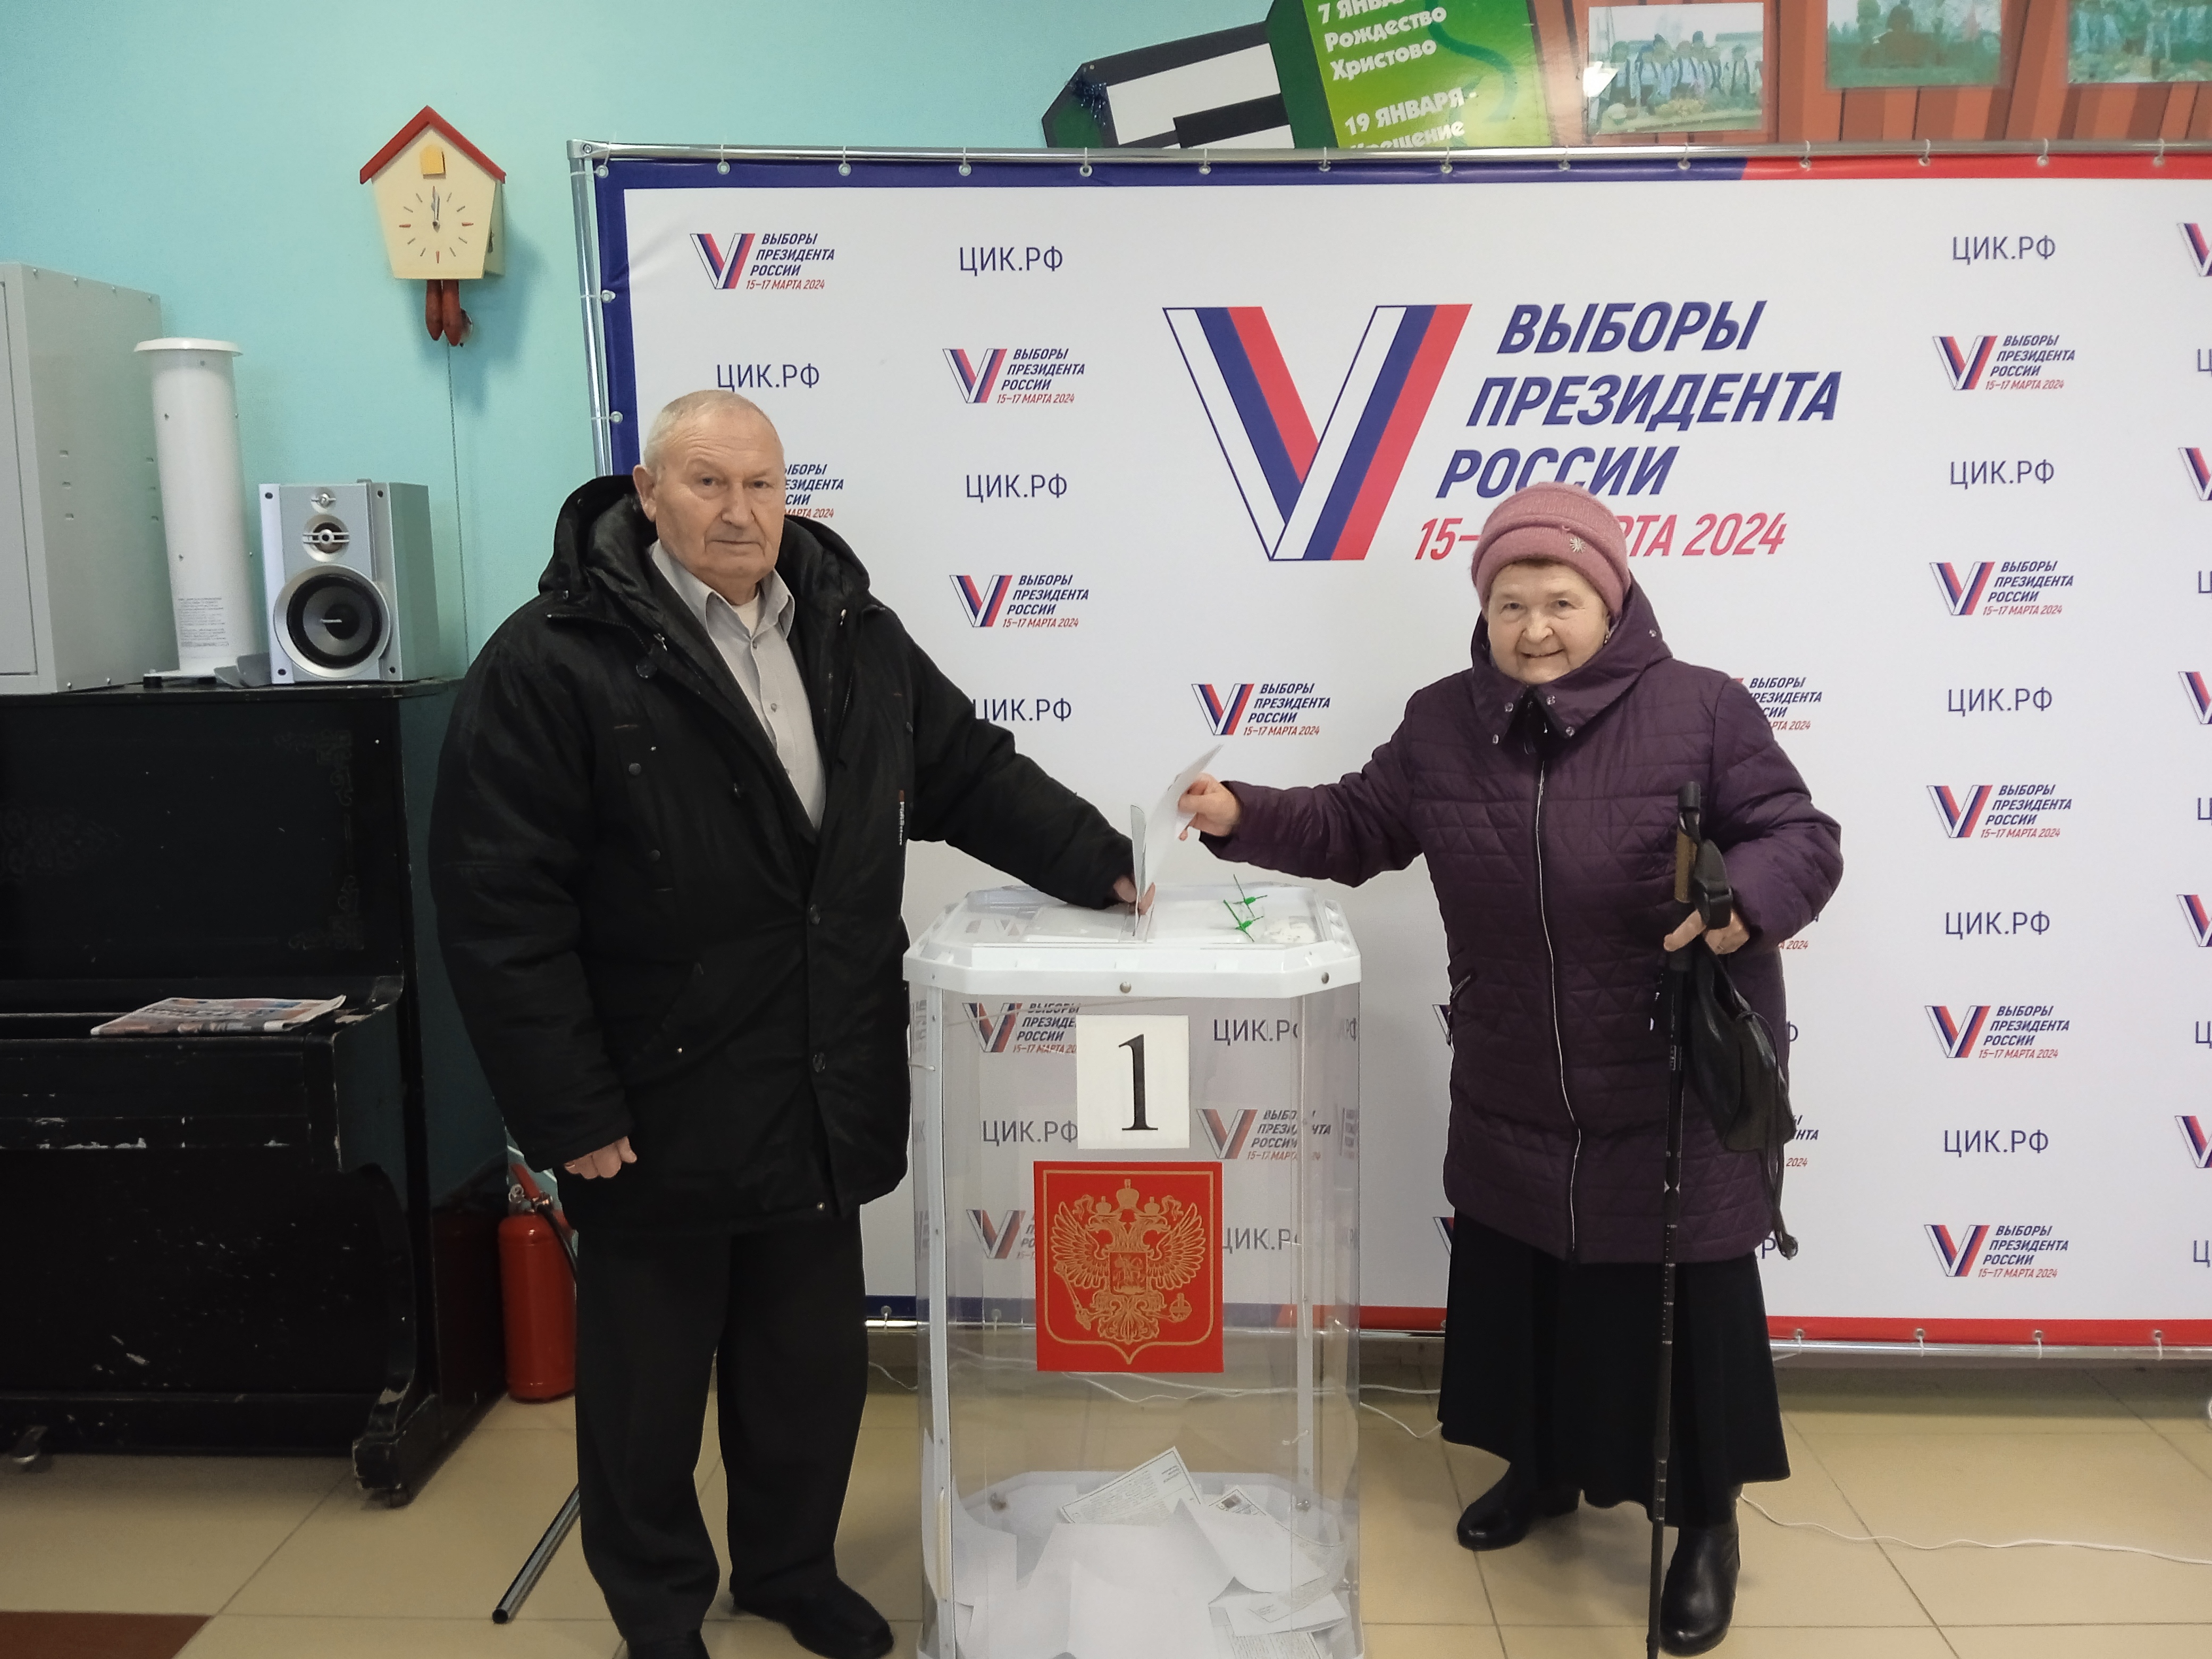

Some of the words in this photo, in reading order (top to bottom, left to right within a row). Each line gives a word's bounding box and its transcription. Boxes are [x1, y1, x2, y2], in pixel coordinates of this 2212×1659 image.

[1317, 1, 1331, 24] 7
[1324, 6, 1447, 53] Рождество
[1329, 38, 1437, 81] Христово
[1344, 112, 1371, 136] 19
[1375, 86, 1466, 129] ЯНВАРЯ
[761, 232, 817, 245] ВЫБОРЫ
[756, 248, 835, 262] ПРЕЗИДЕНТА
[1953, 236, 2055, 265] ЦИК.РФ
[960, 246, 1062, 276] ЦИК.РФ
[750, 264, 800, 276] РОССИИ
[772, 279, 801, 290] МАРТА
[803, 279, 825, 290] 2024
[1497, 299, 1768, 354] ВЫБОРЫ
[2002, 334, 2059, 346] ВЫБОРЫ
[1013, 348, 1068, 360] ВЫБОРЫ
[1996, 349, 2075, 362] ПРЕЗИДЕНТА
[1007, 363, 1085, 376] ПРЕЗИДЕНТА
[1990, 365, 2041, 376] РОССИИ
[717, 363, 818, 392] ЦИК.РФ
[1001, 379, 1051, 390] РОССИИ
[2010, 380, 2040, 389] МАРТА
[2042, 380, 2064, 389] 2024
[1023, 393, 1052, 403] МАРТА
[1054, 393, 1074, 403] 2024
[1466, 370, 1842, 432] ПРЕЗИДЕНТА
[784, 463, 827, 474] БОРЫ
[1436, 446, 1680, 499] РОССИИ
[1950, 459, 2054, 489] ЦИК.РФ
[785, 479, 843, 491] ЕЗИДЕНТА
[966, 473, 1067, 501] ЦИК.РФ
[785, 494, 810, 505] СИИ
[812, 508, 833, 517] 2024
[1414, 517, 1479, 560] 15–
[1682, 512, 1786, 556] 2024
[2001, 560, 2057, 572] ВЫБОРЫ
[1019, 574, 1073, 585] ВЫБОРЫ
[1994, 575, 2073, 588] ПРЕЗИДЕНТА
[1013, 588, 1088, 601] ПРЕЗИДЕНТА
[1988, 590, 2039, 602] РОССИИ
[1007, 604, 1054, 615] РОССИИ
[2009, 605, 2038, 615] МАРТА
[2040, 605, 2062, 615] 2024
[1027, 618, 1057, 627] МАРТА
[1058, 618, 1078, 627] 2024
[1749, 676, 1806, 688] ВЫБОРЫ
[1260, 683, 1314, 694] ВЫБОРЫ
[1254, 697, 1330, 709] ПРЕЗИДЕНТА
[1948, 687, 2052, 716] ЦИК.РФ
[1249, 711, 1296, 723] РОССИИ
[1763, 707, 1787, 717] СИИ
[1269, 726, 1297, 735] МАРТА
[1299, 726, 1319, 735] 2024
[1788, 720, 1810, 729] 2024
[1998, 783, 2055, 795] ВЫБОРЫ
[1991, 798, 2072, 811] ПРЕЗИДЕНТА
[1985, 814, 2037, 825] РОССИИ
[2007, 828, 2036, 838] МАРТА
[2038, 828, 2060, 838] 2024
[1946, 910, 2050, 939] ЦИК.РФ
[1786, 940, 1808, 950] 2024
[1996, 1004, 2053, 1016] ВЫБОРЫ
[1021, 1016, 1075, 1028] ПРЕЗИДЕ
[1989, 1019, 2069, 1032] ПРЕЗИДЕНТА
[1017, 1030, 1064, 1041] РОССИИ
[1982, 1034, 2034, 1046] РОССИИ
[1036, 1043, 1063, 1053] МАРТА
[1065, 1043, 1076, 1053] 20
[2004, 1048, 2034, 1058] МАРТА
[2037, 1048, 2058, 1058] 2024
[1117, 1033, 1159, 1132] 1
[983, 1120, 1077, 1146] ЦИК.РФ
[1944, 1129, 2048, 1157] ЦИК.РФ
[1786, 1157, 1808, 1167] 2024
[1996, 1224, 2052, 1236] ВЫБОРЫ
[1989, 1239, 2068, 1252] ПРЕЗИДЕНТА
[1982, 1253, 2034, 1265] РОССИИ
[2004, 1267, 2034, 1278] МАРТА
[2036, 1267, 2057, 1278] 2024
